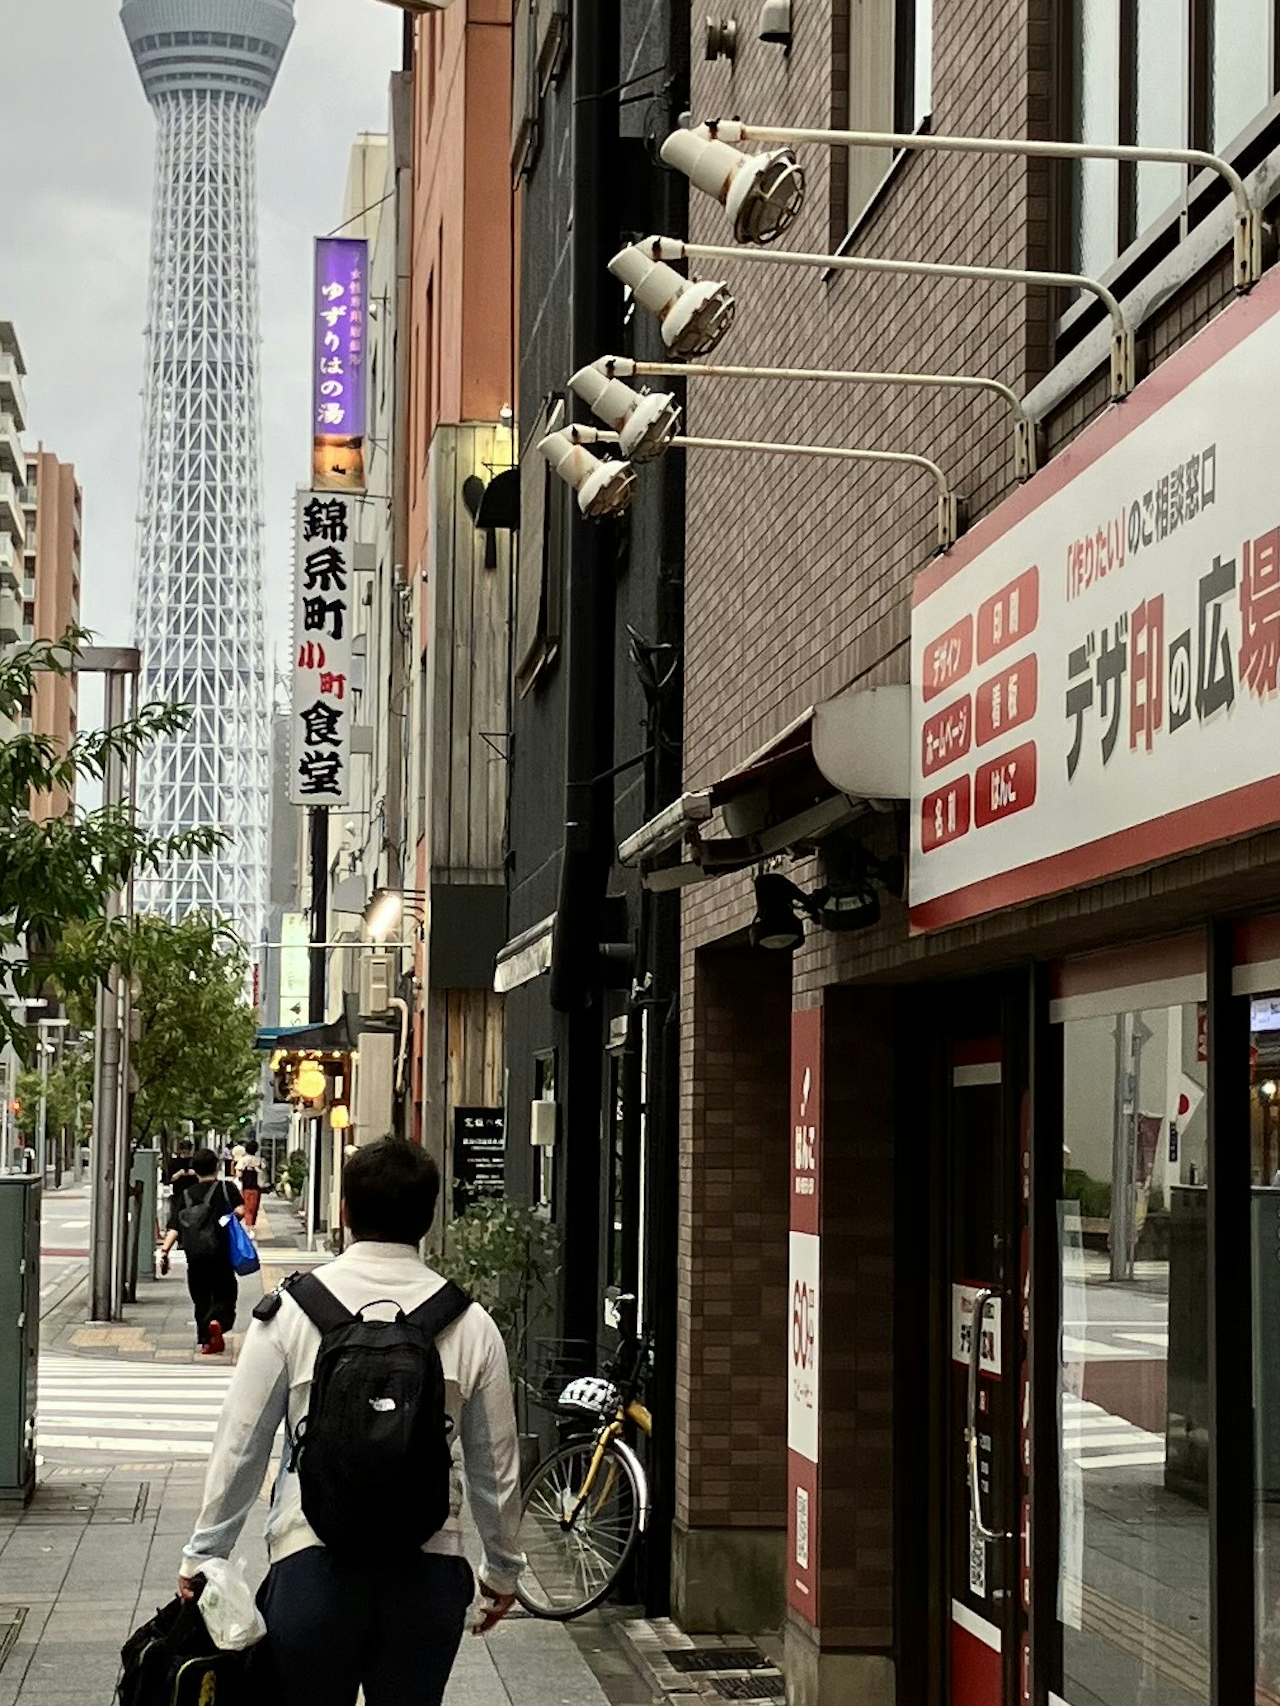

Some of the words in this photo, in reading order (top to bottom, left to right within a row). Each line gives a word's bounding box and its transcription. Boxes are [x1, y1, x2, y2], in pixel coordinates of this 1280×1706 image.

[318, 281, 347, 426] ゆずりはの湯
[932, 637, 962, 687] デザイン
[926, 705, 968, 766] ホームページ
[991, 762, 1017, 811] はんこ
